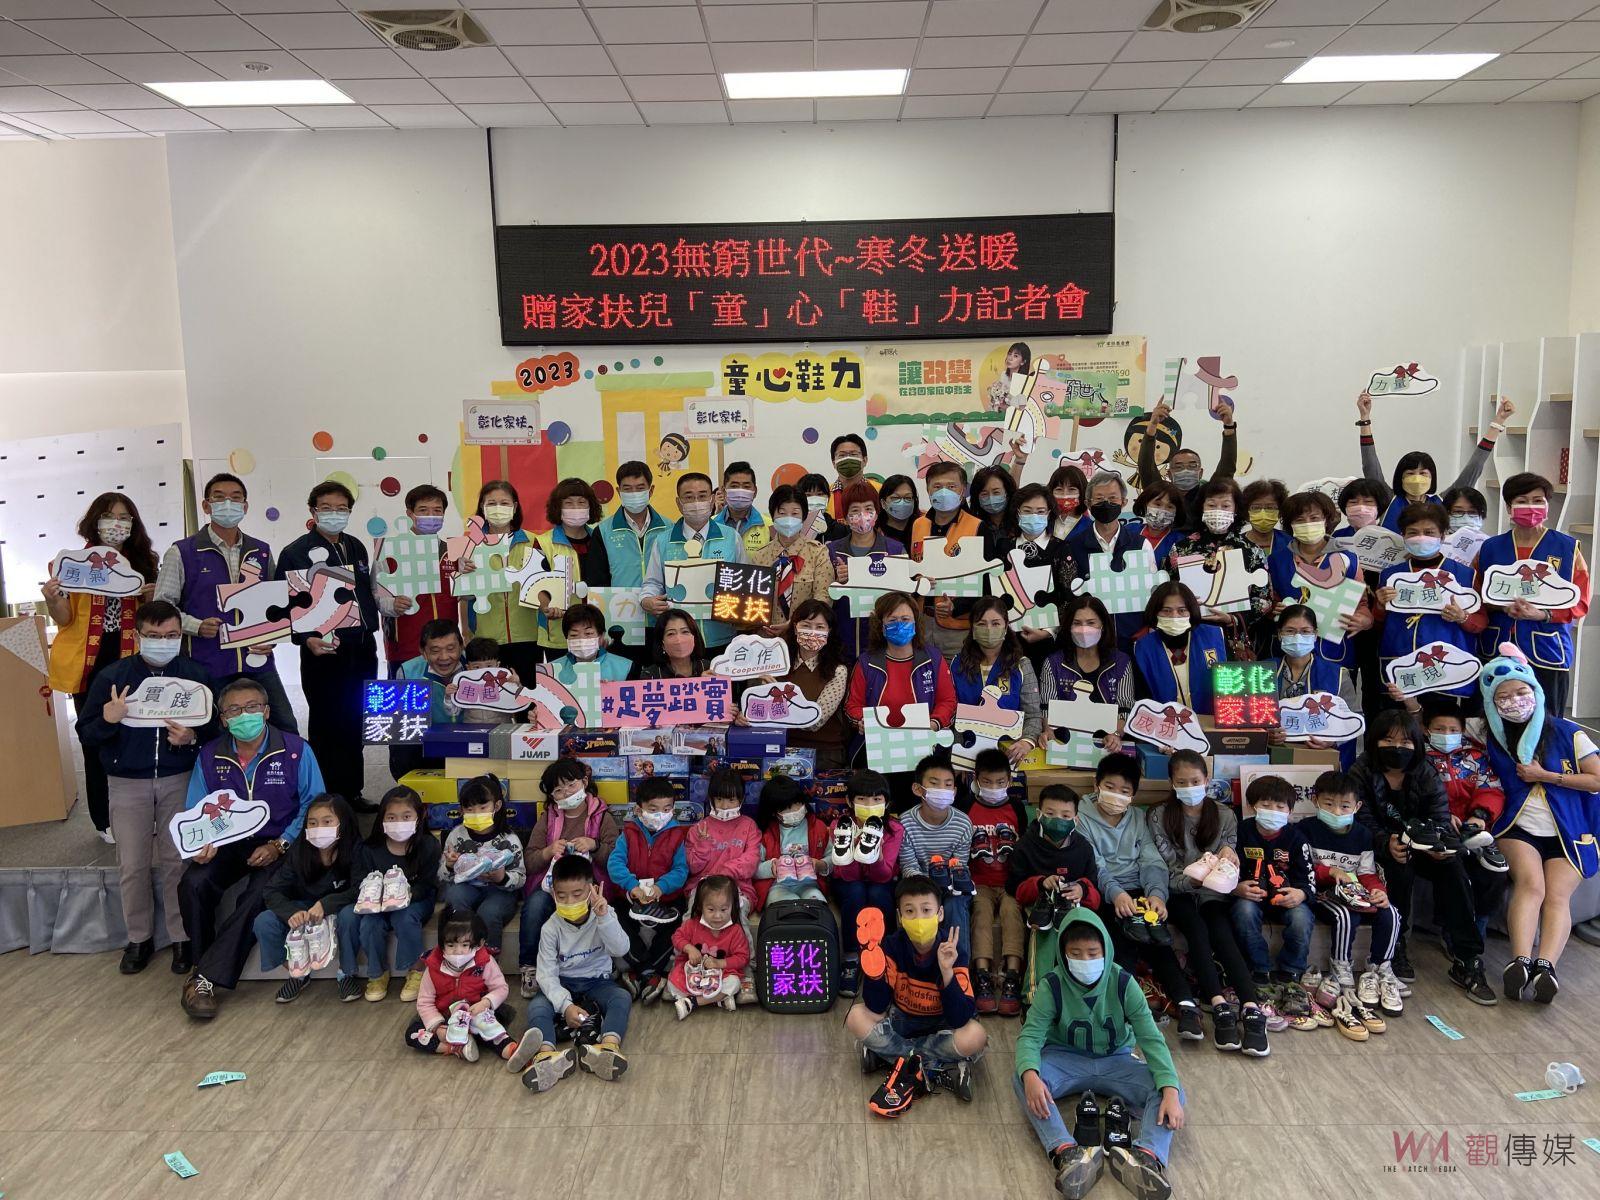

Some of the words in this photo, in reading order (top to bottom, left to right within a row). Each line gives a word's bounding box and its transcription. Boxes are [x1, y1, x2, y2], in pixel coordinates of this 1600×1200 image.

[589, 231, 1020, 278] 2023無窮世代~寒冬送暖
[520, 361, 574, 387] 2023
[724, 356, 861, 396] 童心鞋力
[899, 360, 972, 385] 讓改變
[1375, 379, 1406, 391] 力量
[477, 415, 528, 429] 彰化家扶
[696, 410, 742, 424] 彰化家扶
[1357, 535, 1399, 562] 勇氣
[65, 568, 106, 584] 勇氣
[719, 566, 772, 595] 彰化
[1495, 581, 1536, 595] 力量
[1398, 588, 1438, 603] 實現
[713, 594, 770, 623] 家扶
[734, 646, 773, 665] 合作
[1216, 665, 1277, 694] 彰化
[1401, 667, 1441, 688] 實現
[141, 686, 193, 708] 實踐
[366, 683, 429, 712] 彰化
[462, 685, 497, 700] 串起
[602, 678, 728, 726] #足夢踏實
[1216, 696, 1279, 725] 家扶
[1285, 715, 1326, 730] 勇氣
[364, 714, 429, 741] 家扶
[1136, 716, 1175, 738] 成功
[519, 751, 551, 759] JUMP
[187, 815, 230, 845] 力量
[770, 943, 822, 970] 彰化
[773, 970, 824, 996] 家扶
